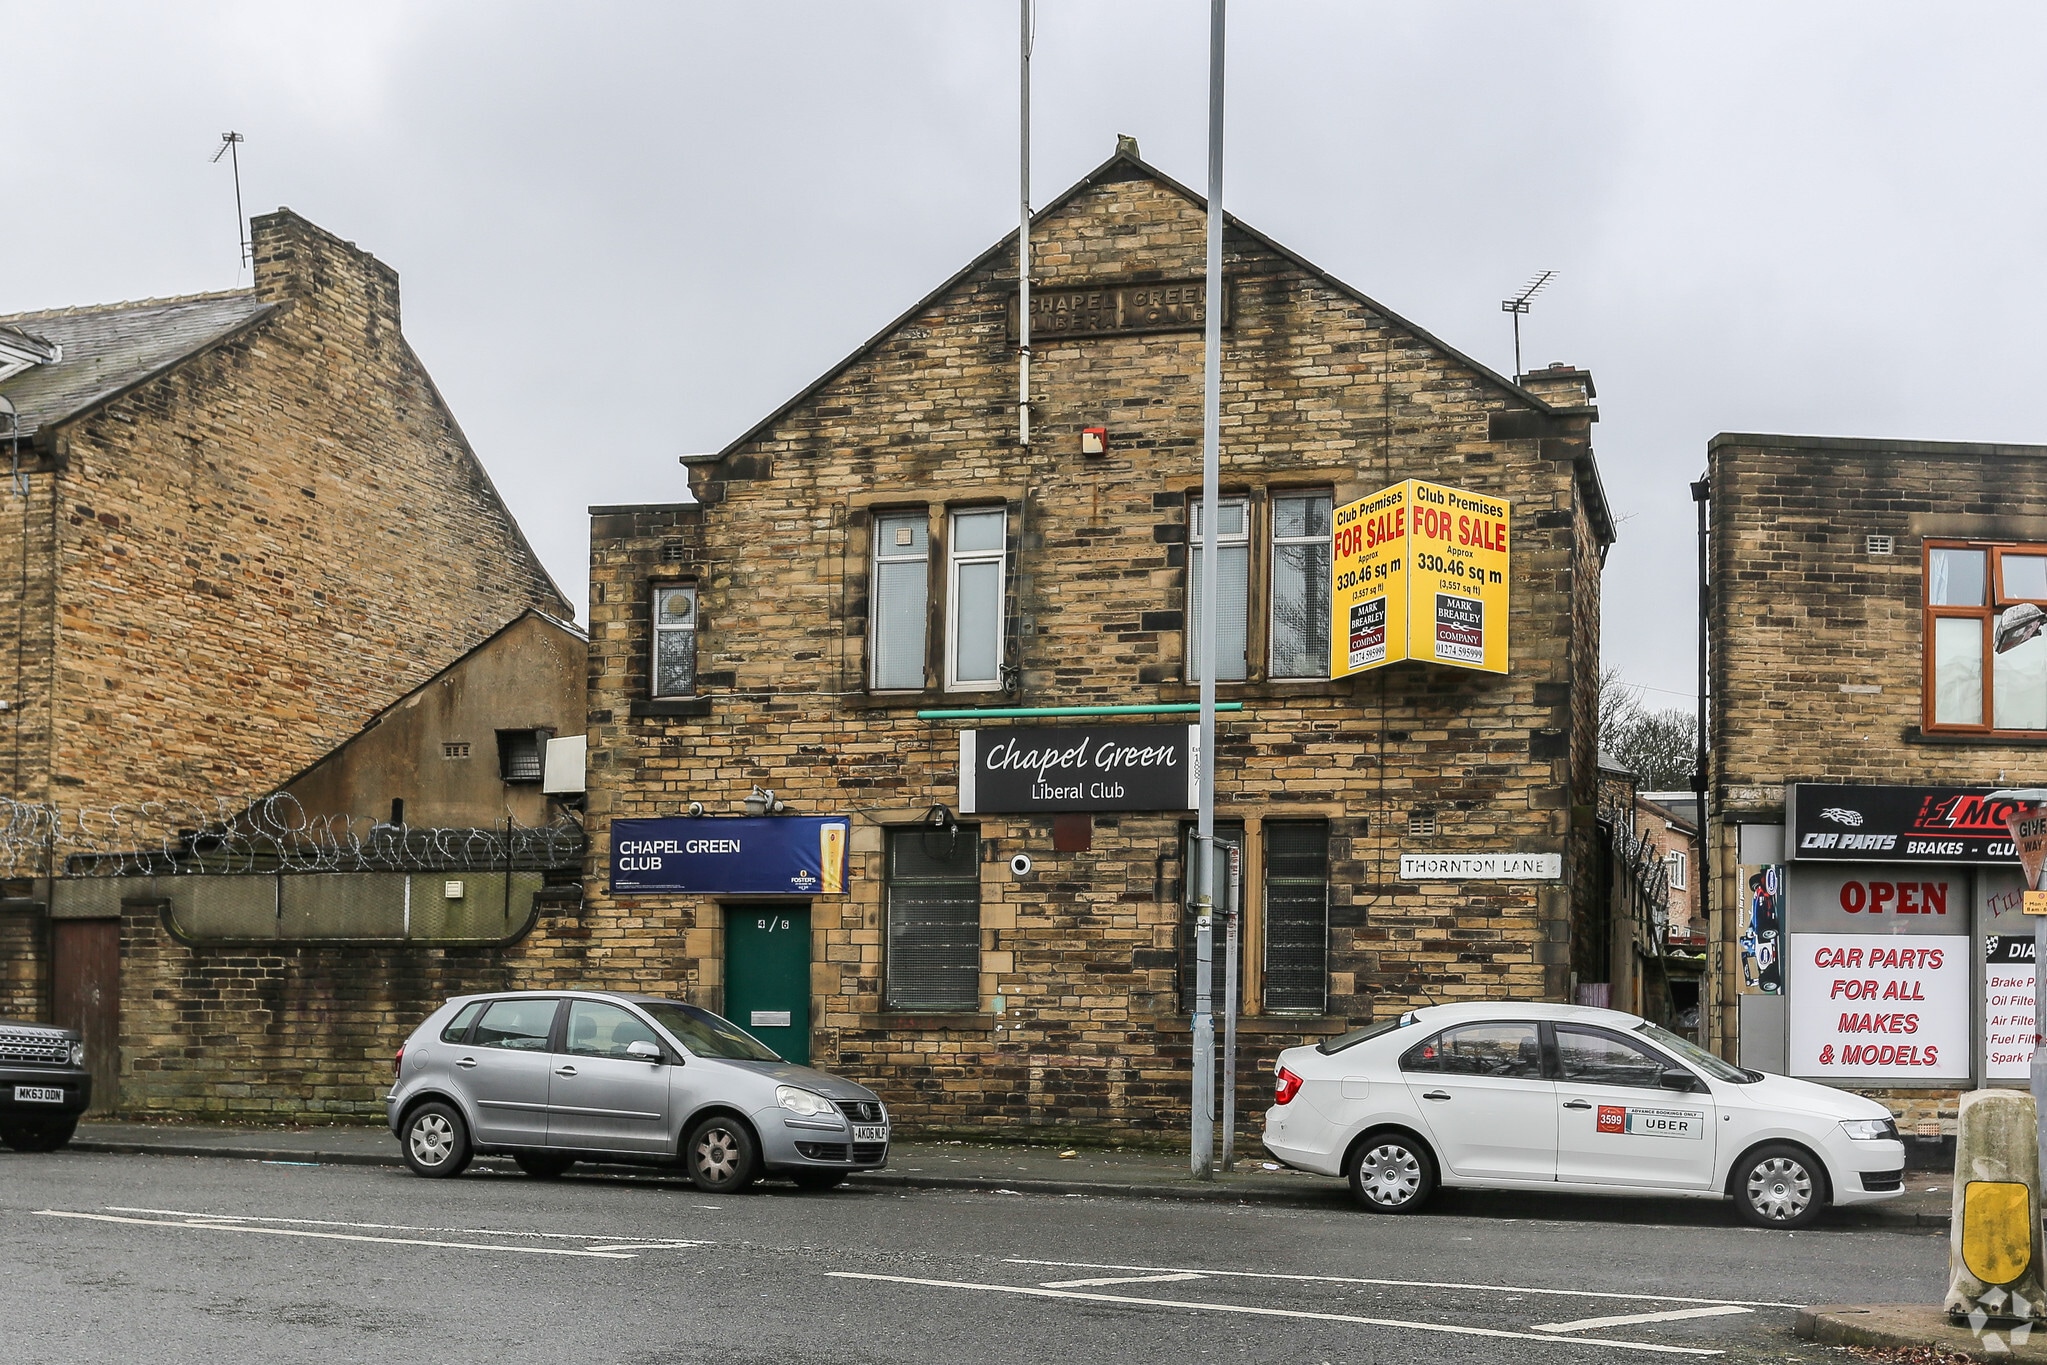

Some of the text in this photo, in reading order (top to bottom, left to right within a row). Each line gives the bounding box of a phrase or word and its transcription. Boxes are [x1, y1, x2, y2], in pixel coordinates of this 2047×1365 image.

[1029, 293, 1118, 314] CHAPEL
[1031, 306, 1206, 332] LIBERAL CLUB
[1338, 491, 1402, 526] Club Premises
[1417, 486, 1503, 518] Club Premises
[1334, 507, 1404, 560] FOR SALE
[1413, 506, 1506, 552] FOR SALE
[1358, 550, 1378, 564] Approx
[1447, 546, 1474, 558] Approx
[1337, 558, 1400, 591] 330.46 sq m
[1418, 553, 1502, 585] 330.46 sq m
[1352, 587, 1369, 601] (3,557
[1370, 585, 1377, 596] sq
[1439, 580, 1480, 595] (3,557 sq ft)
[1358, 602, 1378, 617] MARK
[1446, 599, 1472, 610] MARK
[1352, 611, 1384, 629] BREARLEY
[1438, 608, 1480, 623] BREARLEY
[1360, 626, 1375, 636] &
[1451, 621, 1469, 631] &
[1352, 633, 1382, 650] COMPANY
[1439, 630, 1478, 644] COMPANY
[1365, 647, 1385, 660] 595999
[1436, 643, 1482, 659] 01274 595999
[986, 737, 1176, 783] Chapel Green
[1032, 782, 1124, 800] Liberal Club
[1914, 796, 1933, 828] THE
[2020, 818, 2047, 838] GIVE
[619, 840, 740, 854] CHAPEL GREEN
[1800, 832, 1898, 850] CAR PARTS
[2024, 840, 2043, 852] WAY
[1906, 842, 1963, 854] BRAKES
[1987, 843, 2019, 856] CLU
[619, 857, 662, 870] CLUB
[1406, 860, 1494, 872] THORNTON
[1504, 860, 1544, 872] LANE
[1840, 880, 1948, 915] OPEN
[1814, 948, 1944, 969] CAR PARTS
[1830, 980, 1926, 1000] FOR ALL
[1991, 977, 2023, 988] Brake
[1992, 996, 2007, 1006] Oil
[1838, 1013, 1920, 1033] MAKES
[1991, 1016, 2008, 1026] Air
[1990, 1034, 2014, 1044] Fuel
[1818, 1044, 1938, 1066] & MODELS
[1992, 1052, 2022, 1064] Spark
[20, 1088, 60, 1100] MK63 ODN
[1600, 1114, 1622, 1124] 3599
[1646, 1119, 1688, 1131] UBER
[858, 1127, 886, 1139] AK06 NLP
